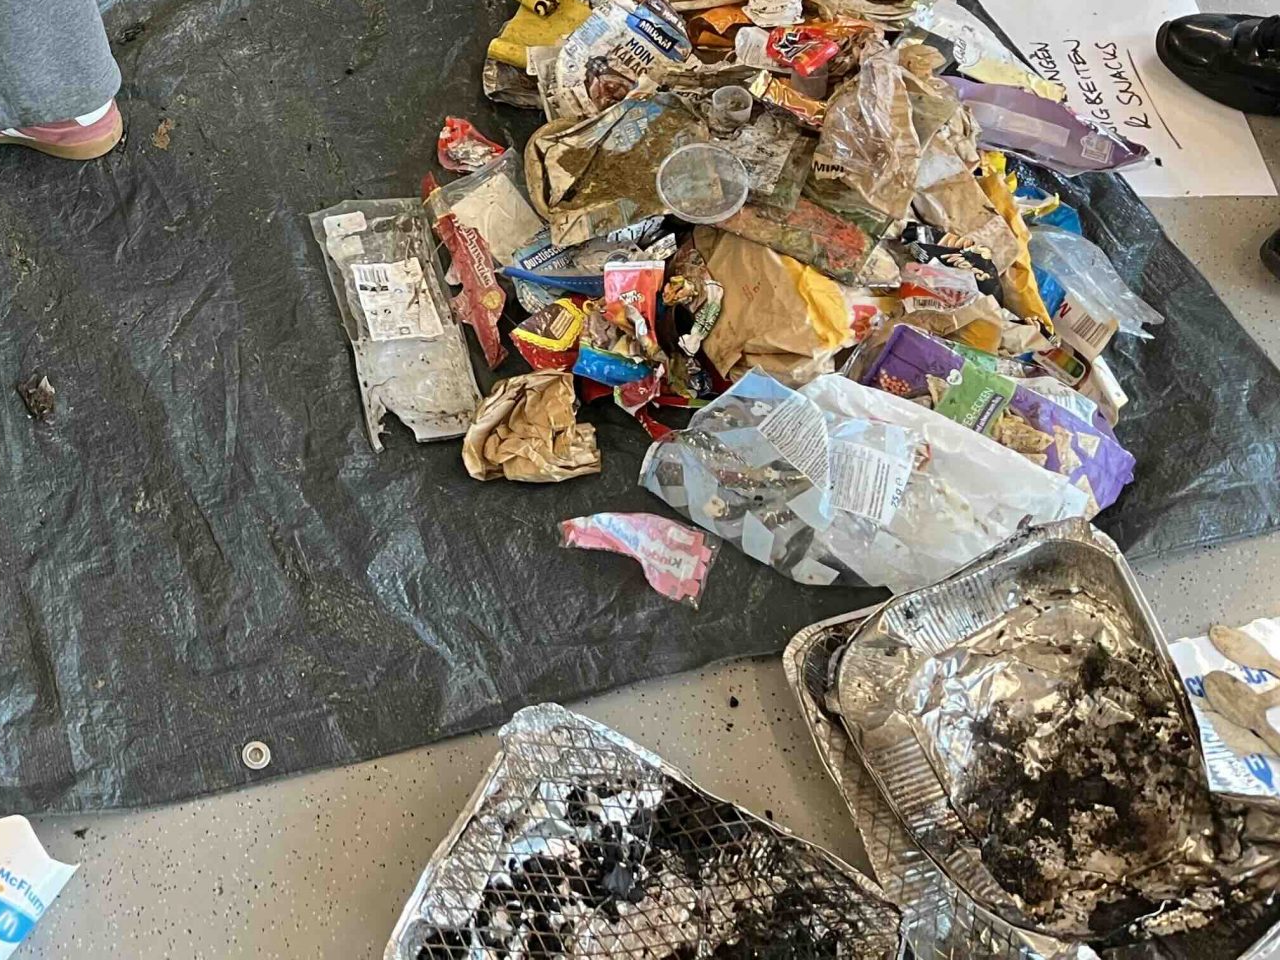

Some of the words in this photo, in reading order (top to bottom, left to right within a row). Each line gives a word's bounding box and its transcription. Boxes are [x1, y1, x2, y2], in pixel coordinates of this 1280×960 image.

[639, 20, 673, 50] MILRAM
[626, 37, 655, 65] MOIN
[1030, 42, 1067, 93] UNGEN
[1095, 41, 1143, 106] SNACKS
[812, 161, 844, 172] MINI
